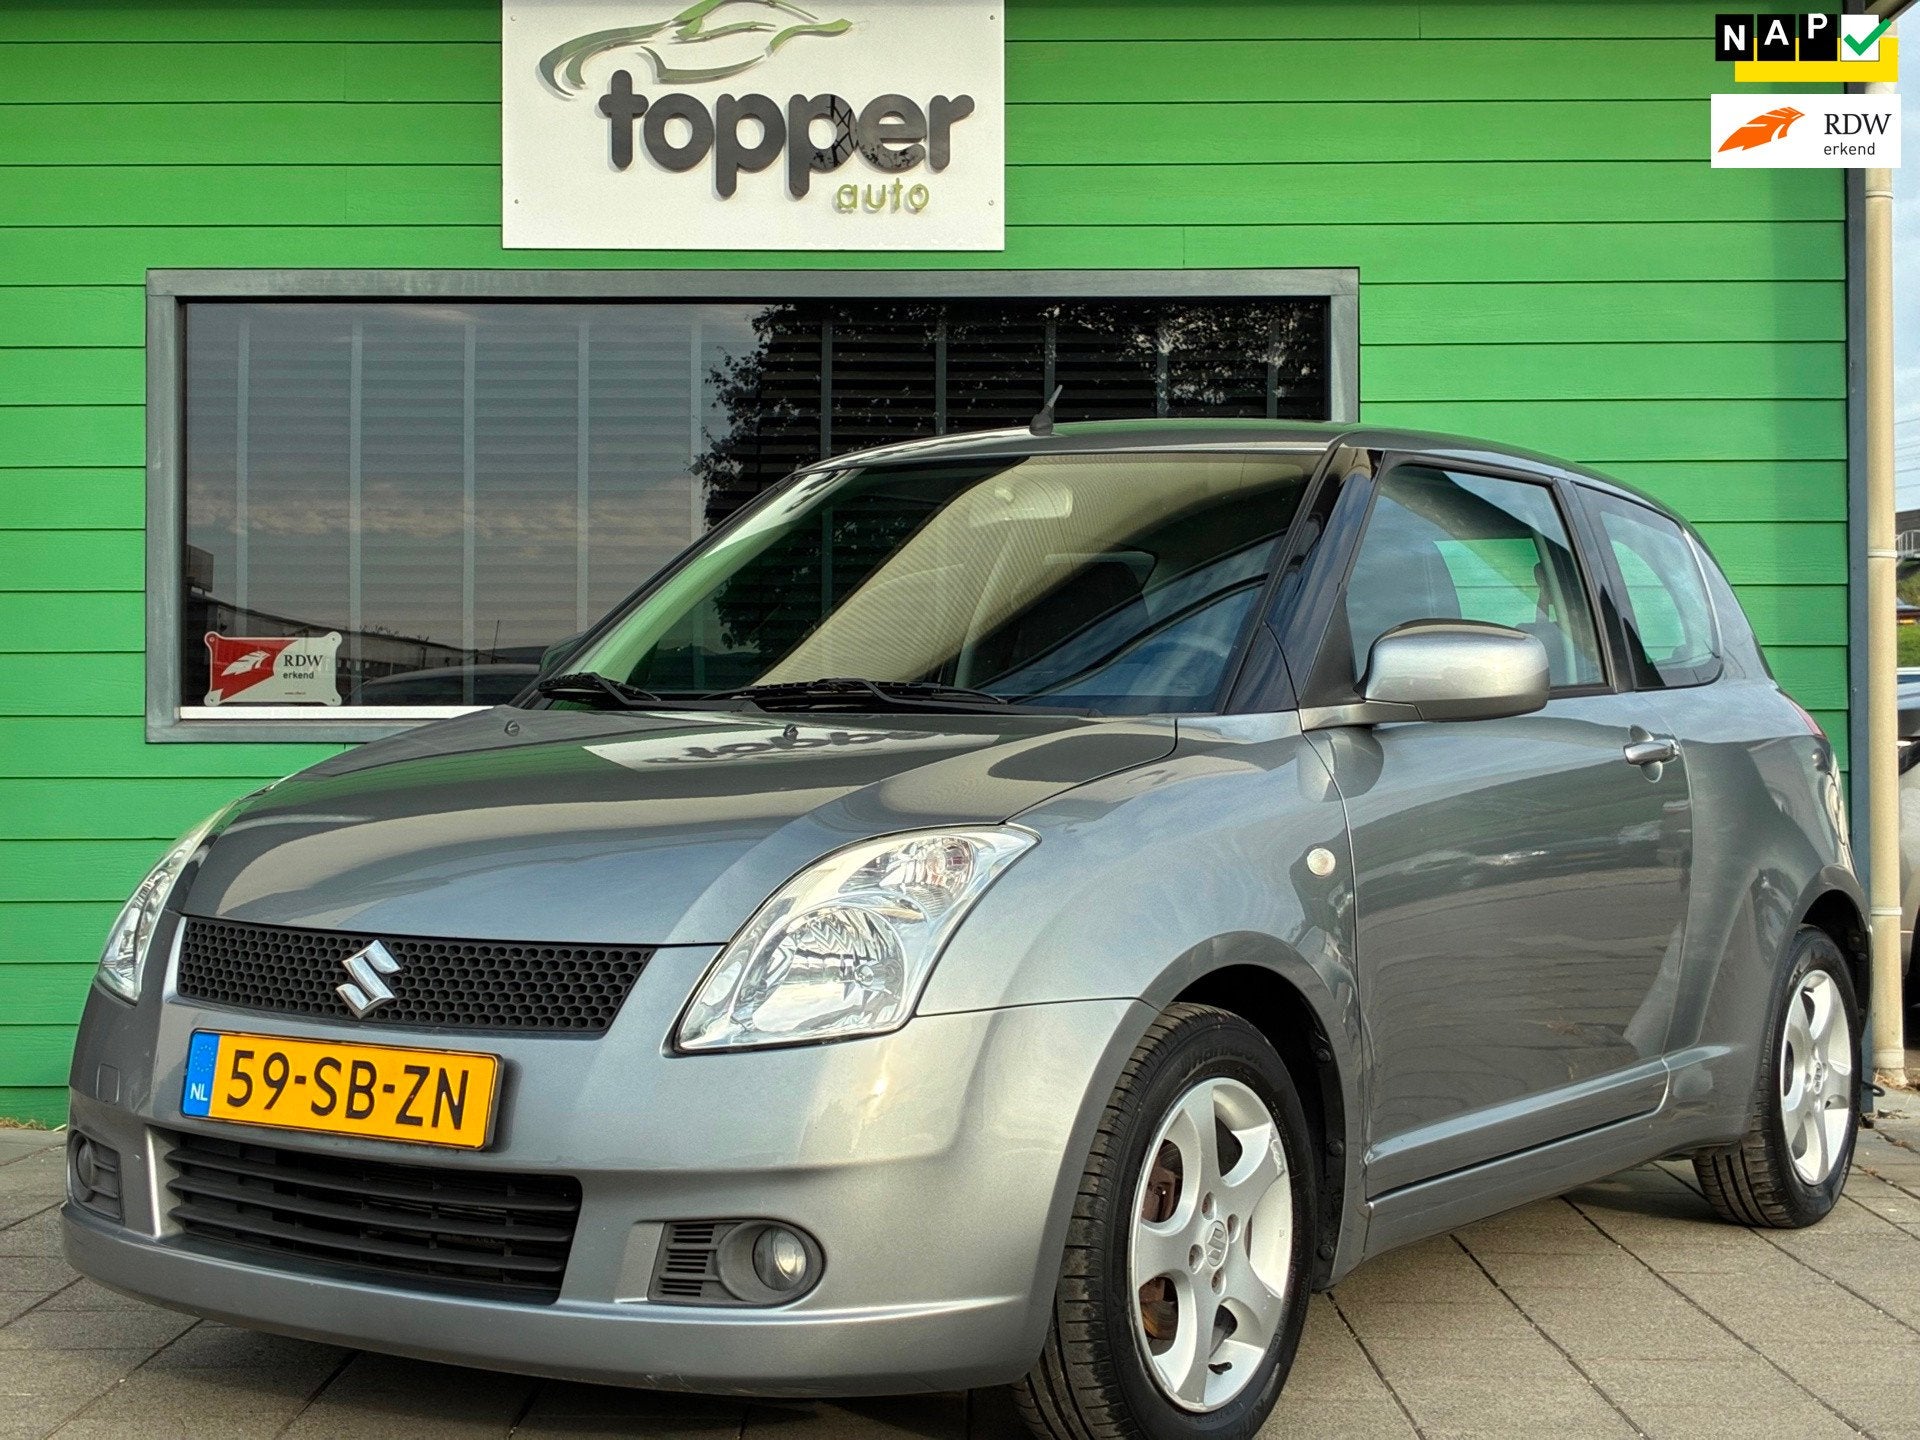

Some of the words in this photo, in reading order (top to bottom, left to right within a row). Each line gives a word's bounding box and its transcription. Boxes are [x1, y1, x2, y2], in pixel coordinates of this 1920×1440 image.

[598, 69, 976, 200] topper
[835, 177, 931, 211] auto
[283, 654, 324, 667] RDW
[282, 671, 315, 680] erkend
[189, 1082, 209, 1102] NL
[226, 1049, 470, 1131] 59-SB-ZN
